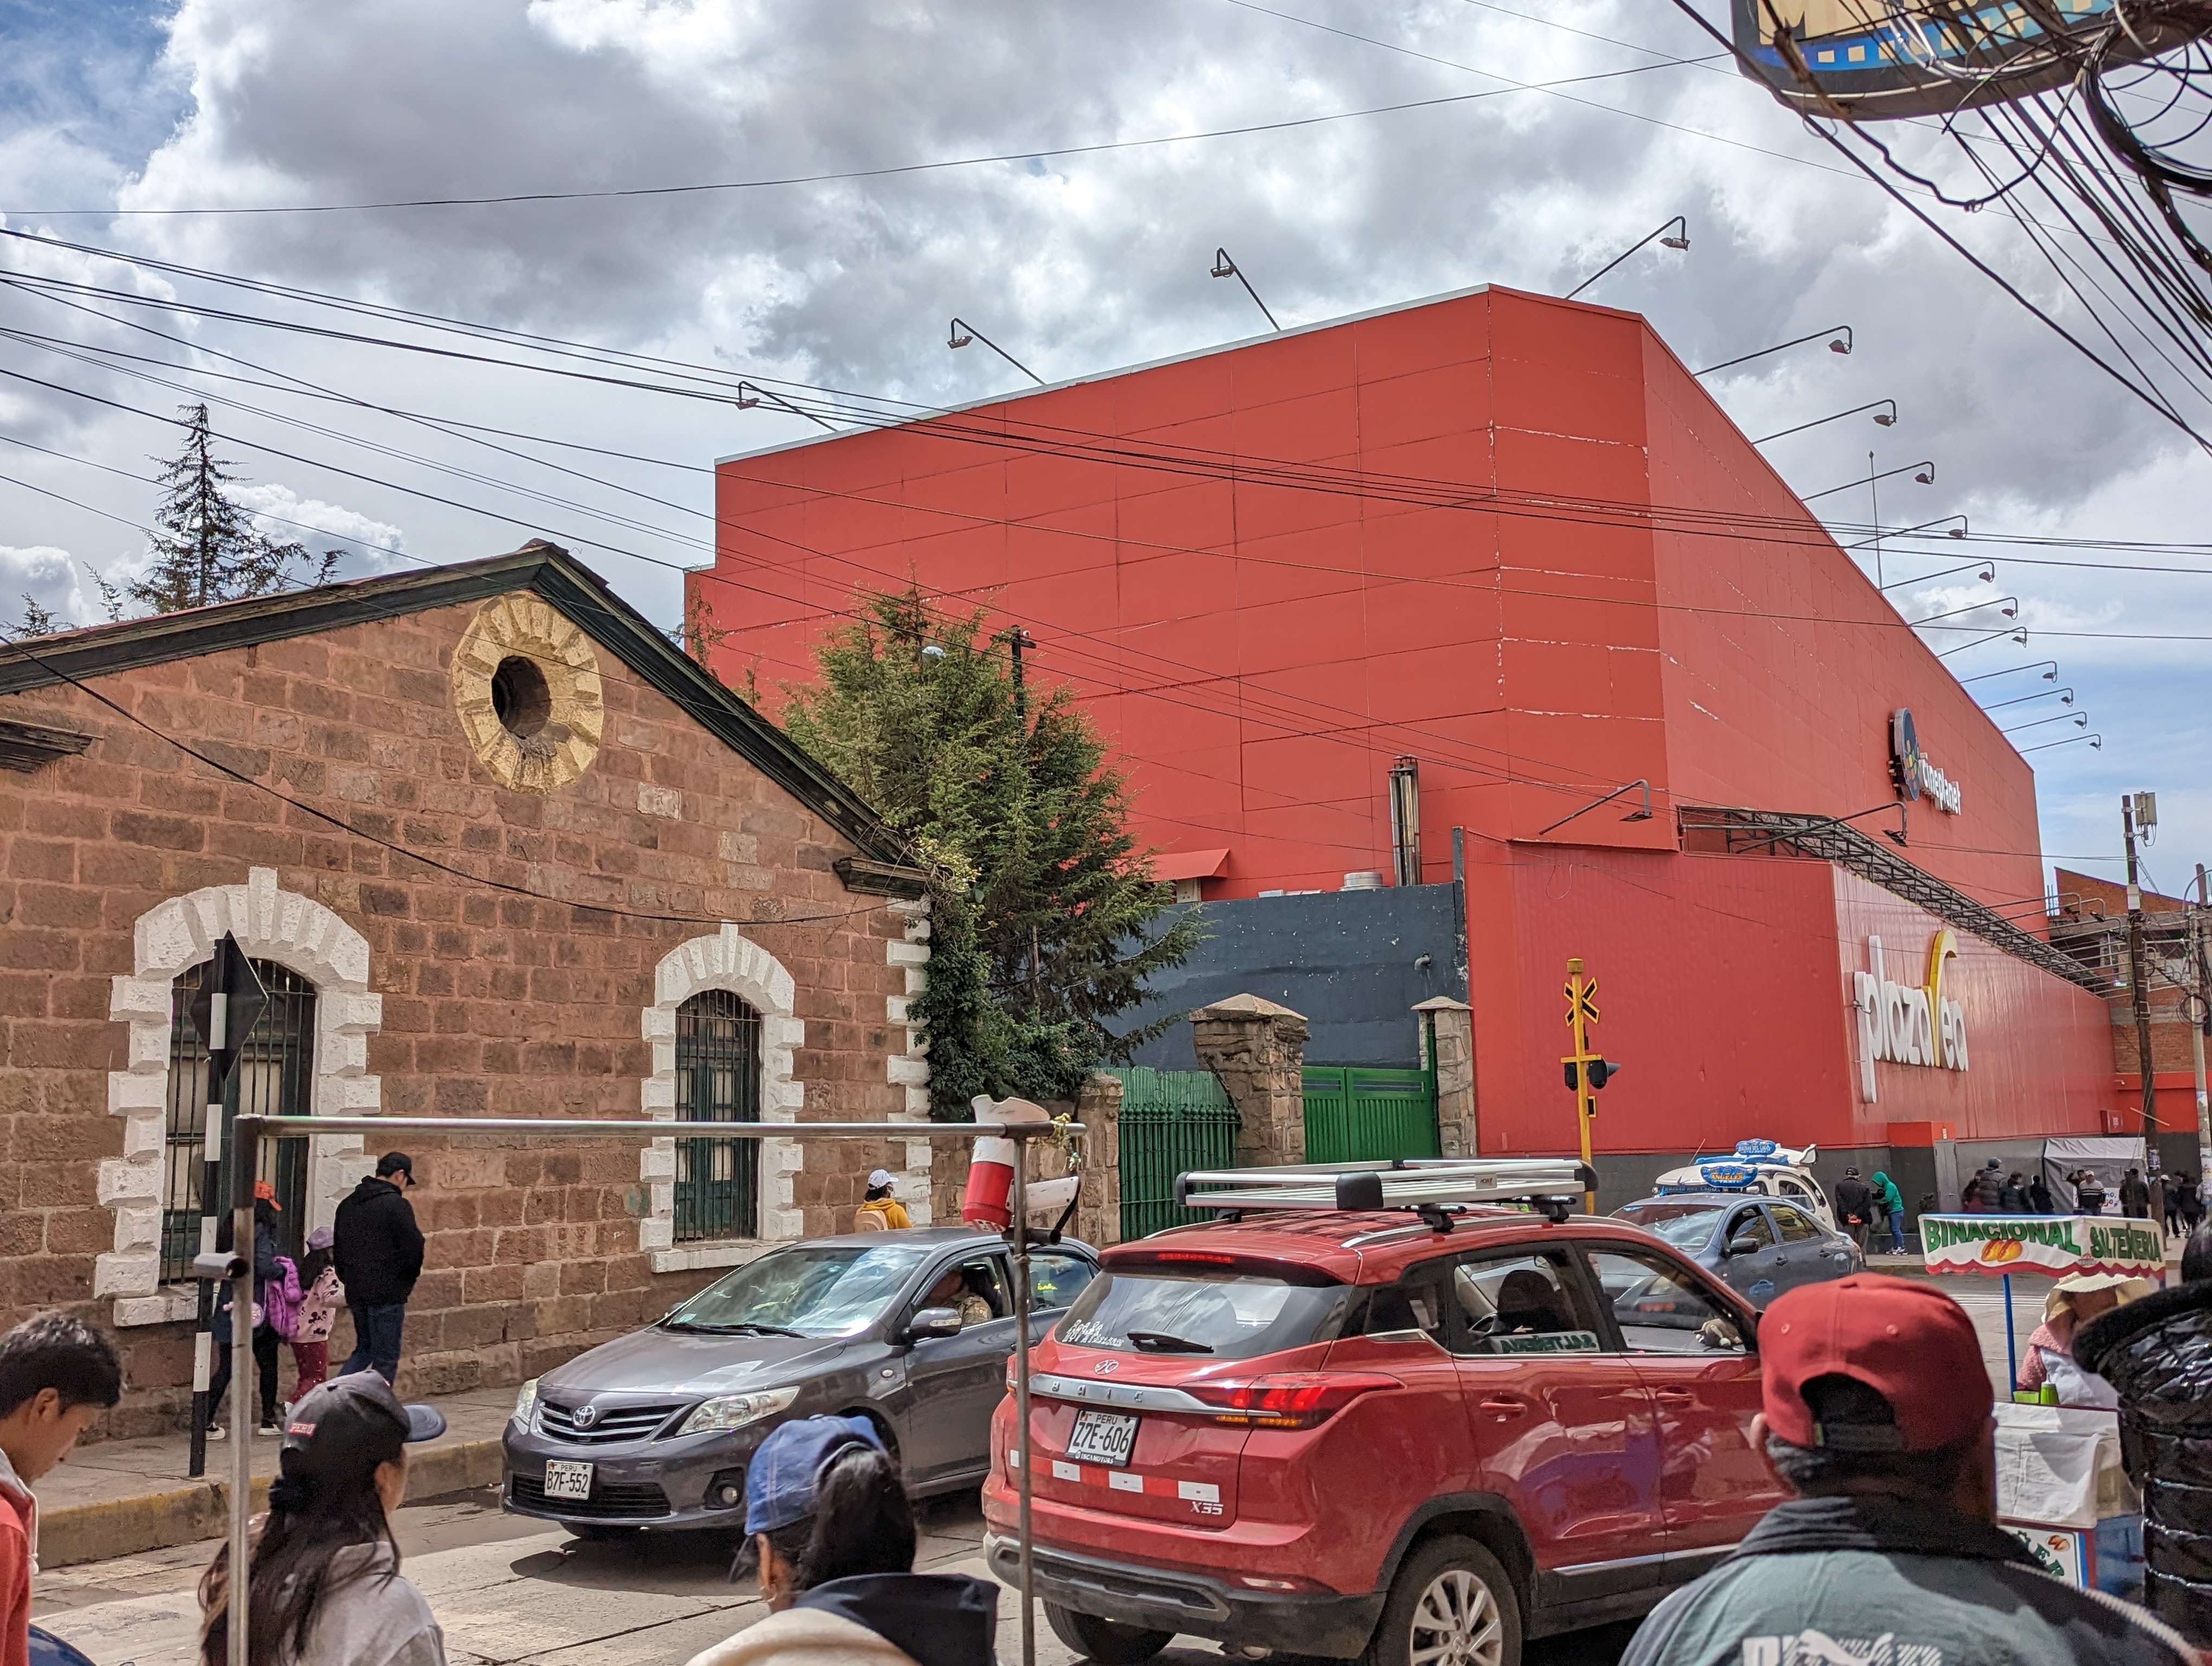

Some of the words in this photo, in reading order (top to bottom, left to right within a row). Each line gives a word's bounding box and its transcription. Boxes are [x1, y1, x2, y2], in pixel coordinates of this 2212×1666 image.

[1918, 752, 1961, 815] cineplanet
[1924, 1219, 2082, 1256] BINACIONAL
[1051, 1380, 1144, 1403] BAIC
[1095, 1414, 1118, 1425] PERU
[1072, 1421, 1131, 1454] Z7E-606
[546, 1470, 589, 1494] B7F-552
[1190, 1501, 1224, 1515] X35
